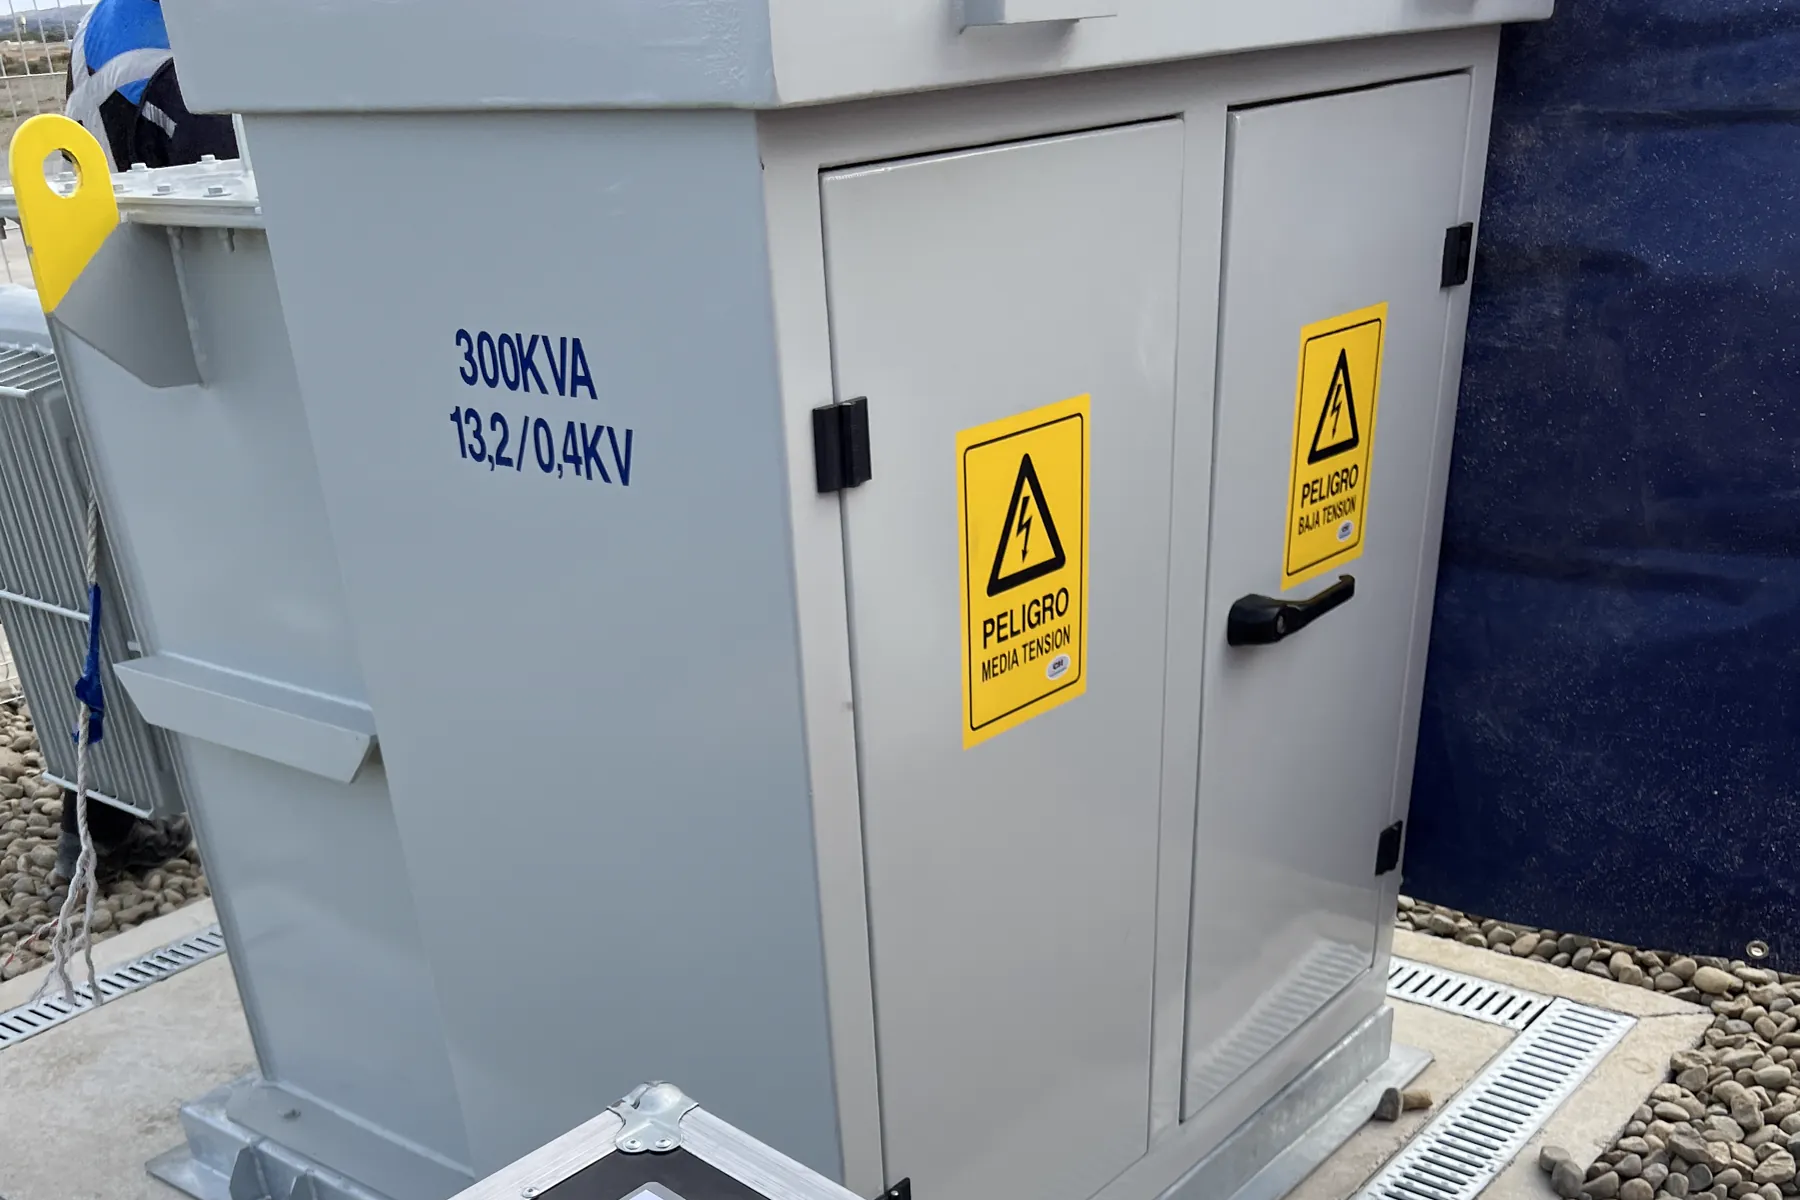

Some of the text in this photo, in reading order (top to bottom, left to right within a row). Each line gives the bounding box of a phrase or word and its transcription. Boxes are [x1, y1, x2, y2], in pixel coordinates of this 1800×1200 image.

[455, 328, 598, 400] 300KVA
[450, 405, 633, 486] 13,2/0,4KV
[1298, 495, 1356, 535] BAJA TENSION
[1301, 464, 1359, 508] PELIGRO
[983, 587, 1069, 649] PELIGRO
[982, 624, 1070, 682] MEDIA TENSION
